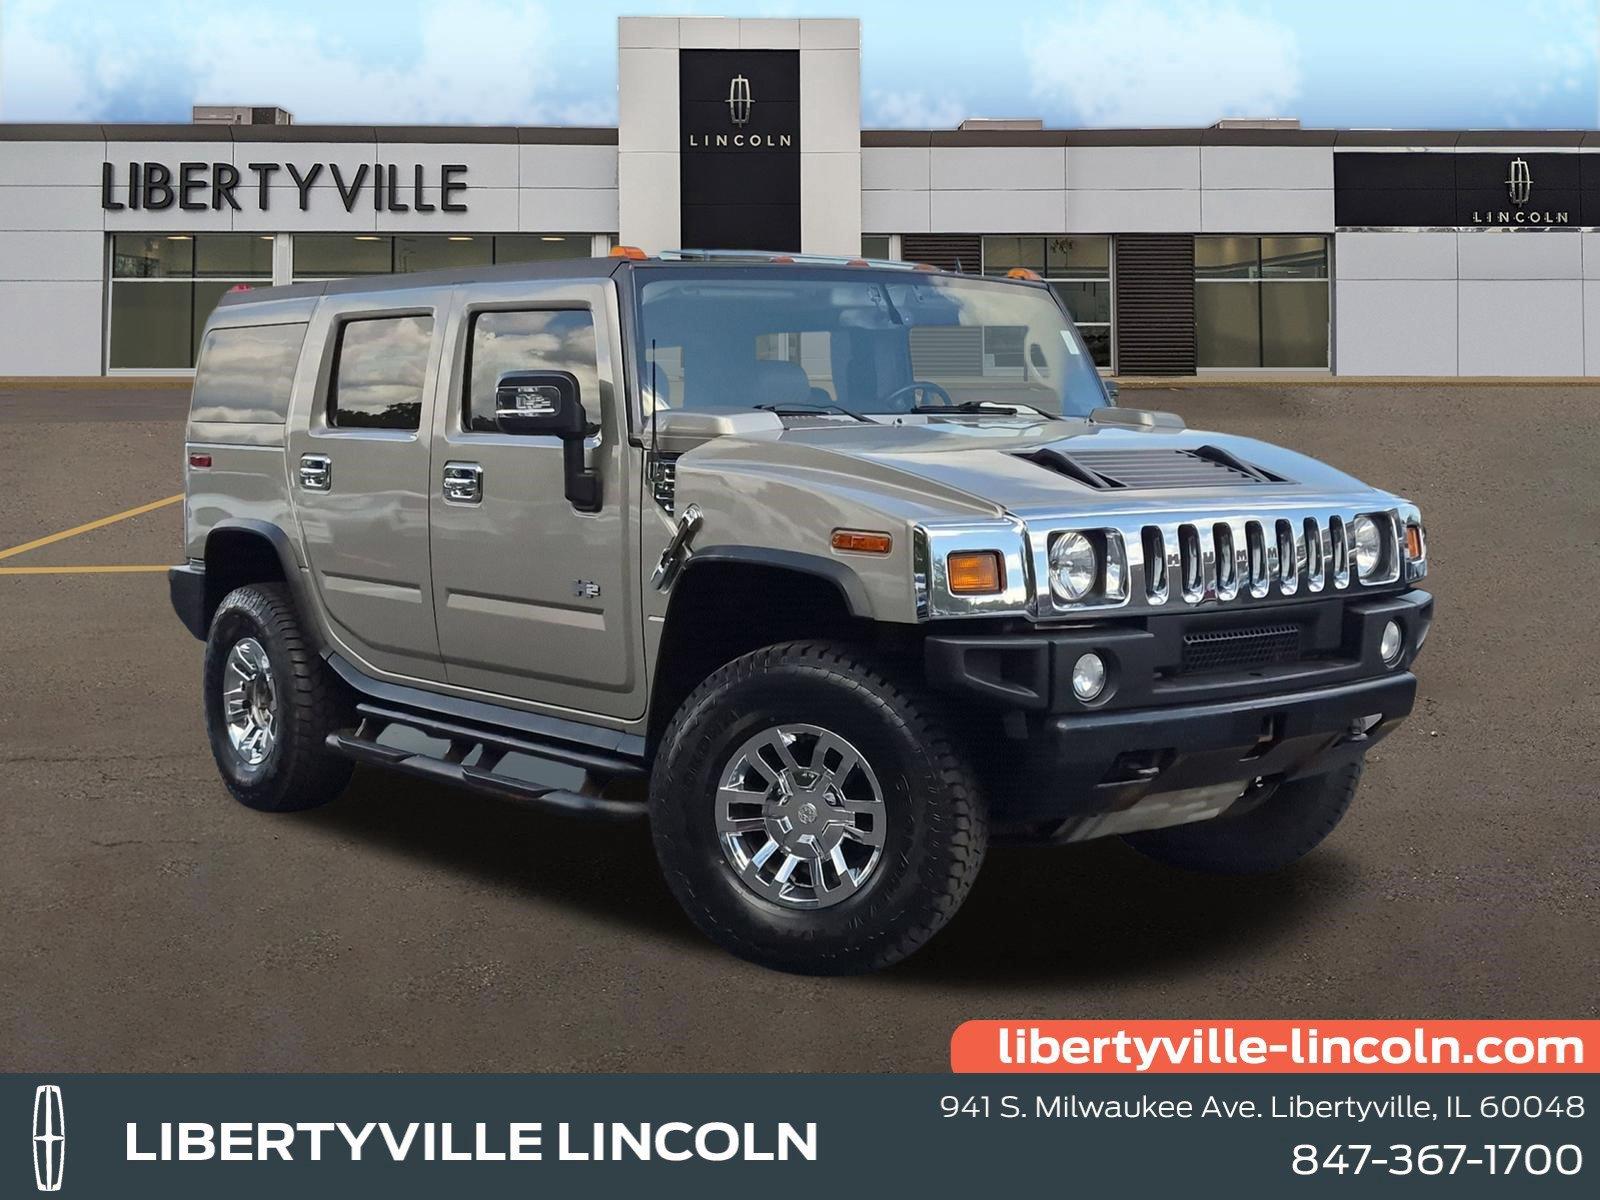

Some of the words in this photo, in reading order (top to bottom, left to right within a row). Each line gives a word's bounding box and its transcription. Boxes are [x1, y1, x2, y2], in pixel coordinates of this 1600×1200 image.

[690, 134, 791, 147] LINCOLN
[102, 162, 470, 213] LIBERTYVILLE
[1473, 211, 1568, 223] LINCOLN
